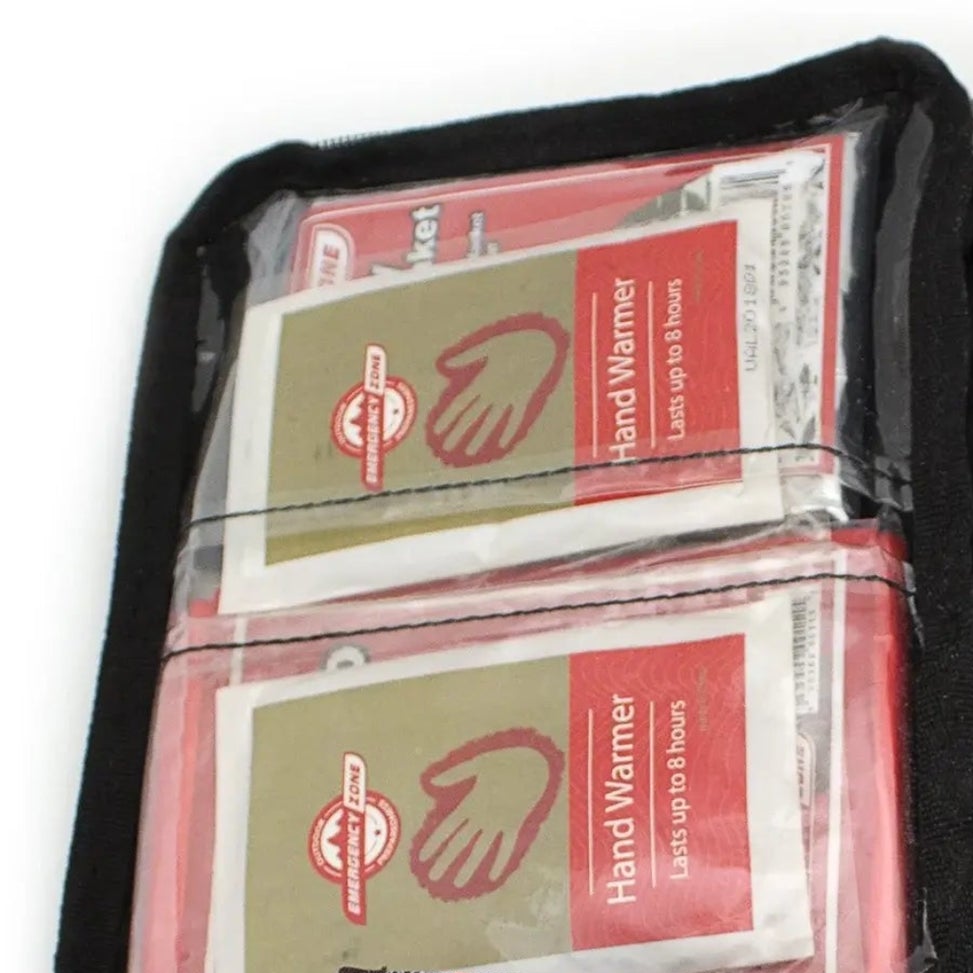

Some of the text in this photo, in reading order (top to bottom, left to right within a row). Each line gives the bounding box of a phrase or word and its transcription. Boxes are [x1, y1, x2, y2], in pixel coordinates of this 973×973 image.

[405, 203, 441, 268] ket
[366, 354, 381, 484] EMERGENCY ZONE
[606, 276, 637, 465] Hand Warmer
[661, 277, 688, 442] Lasts up to 8 hours
[347, 762, 362, 916] EMERGENCY ZONE
[603, 692, 638, 906] Hand Warmer
[665, 699, 691, 881] Lasts up to 8 hours
